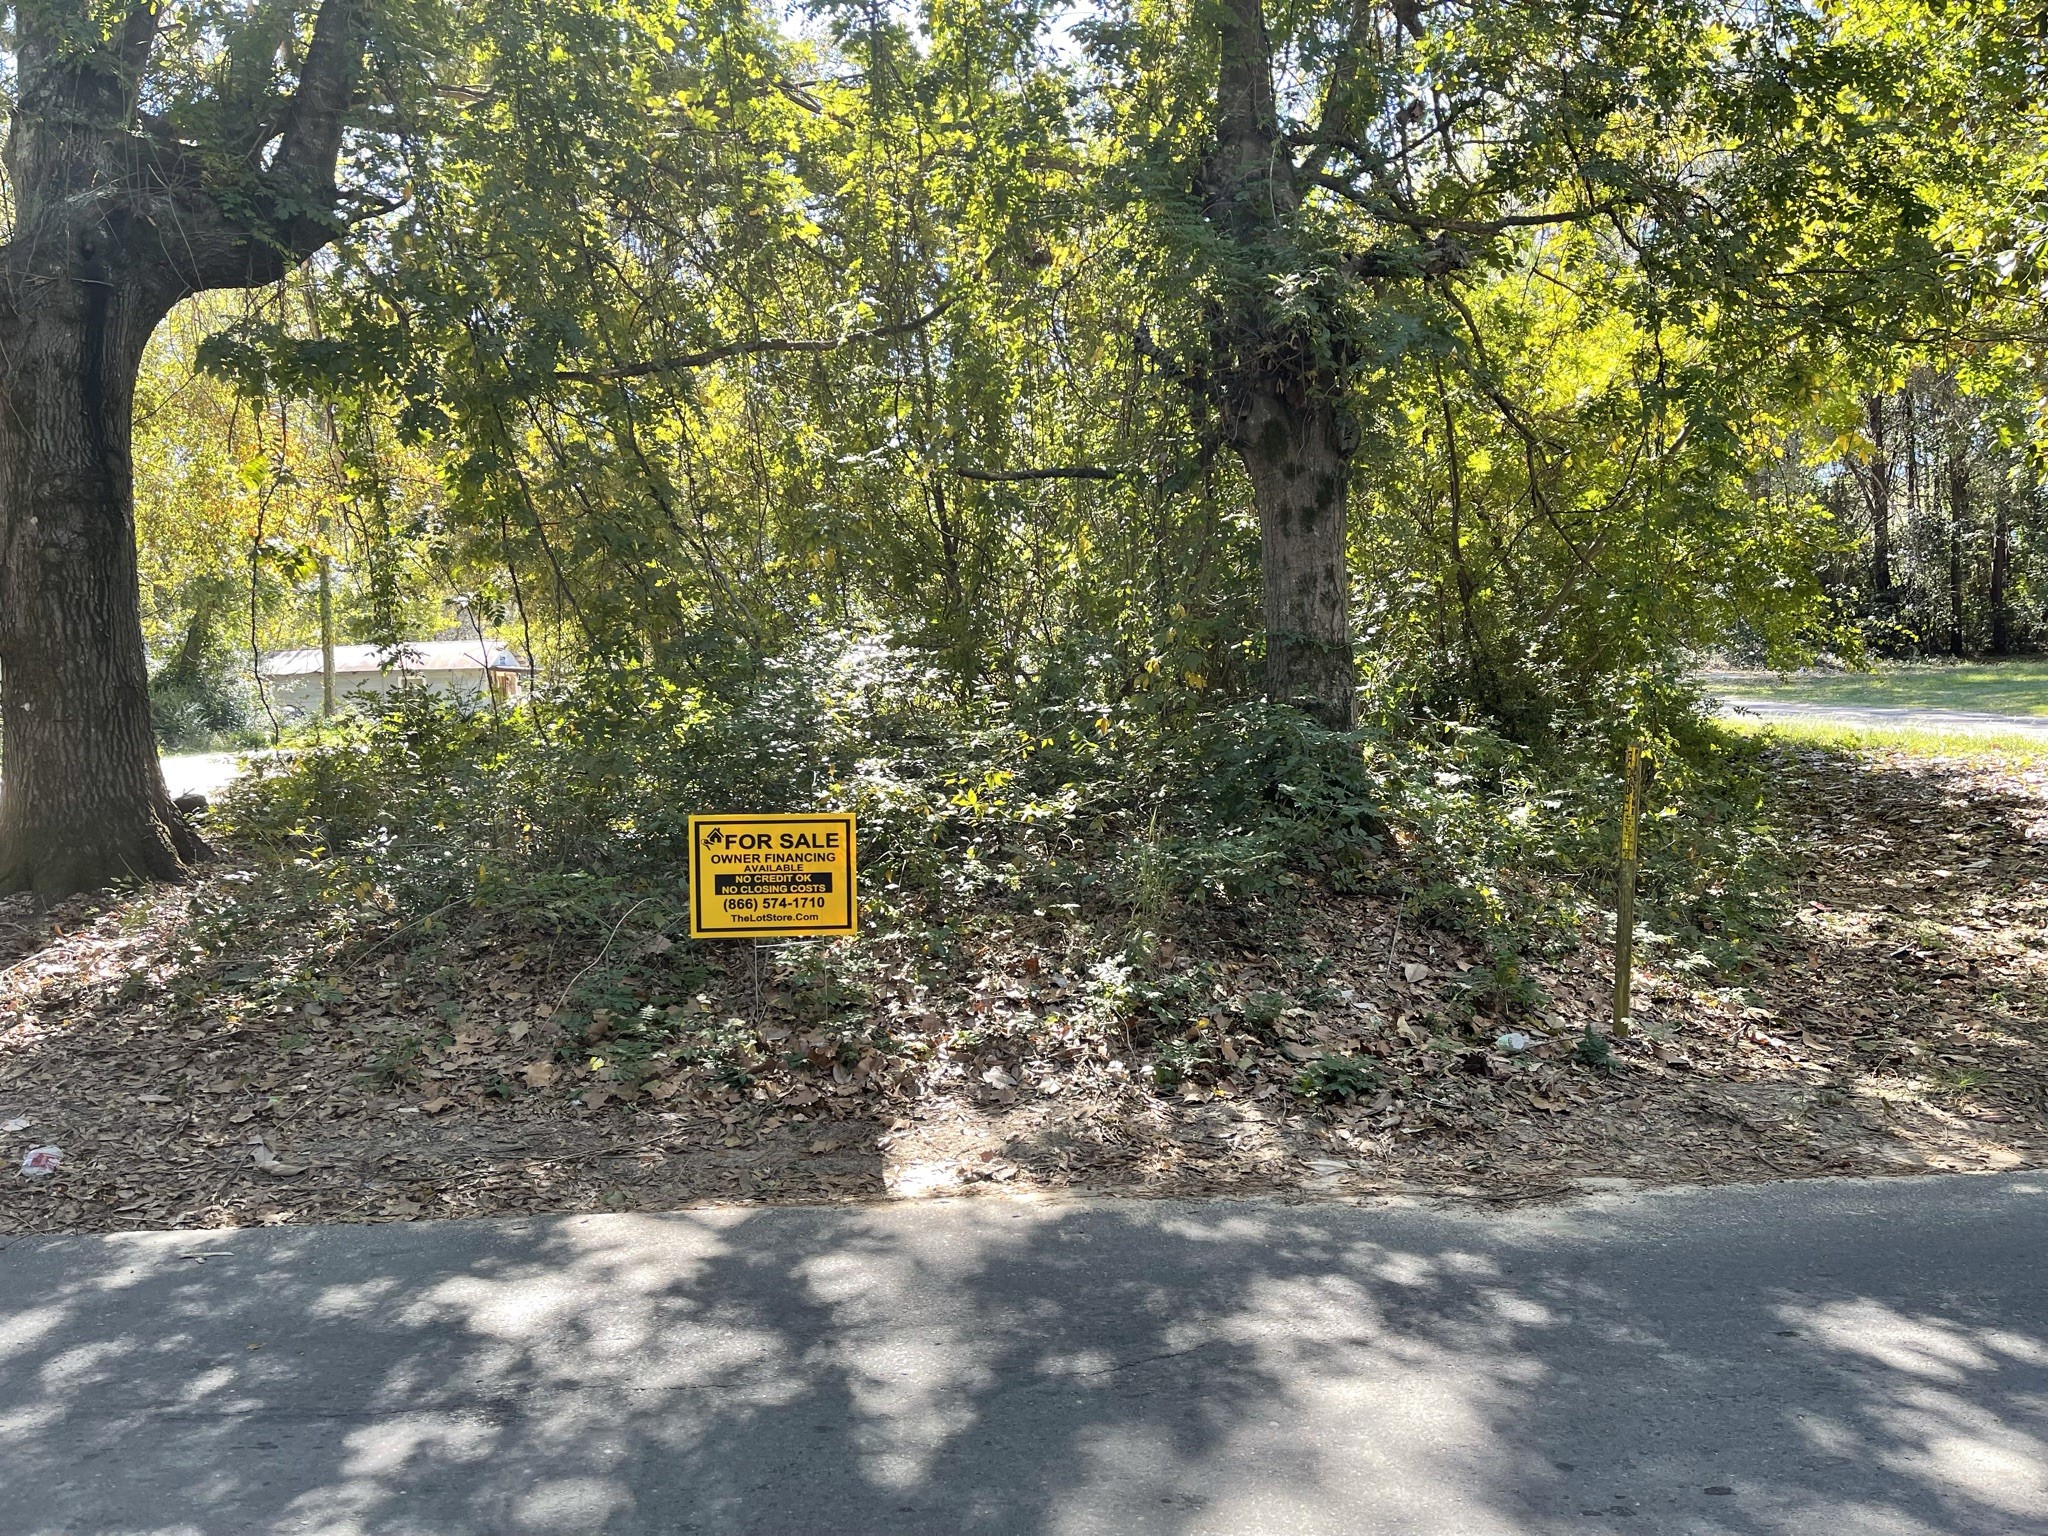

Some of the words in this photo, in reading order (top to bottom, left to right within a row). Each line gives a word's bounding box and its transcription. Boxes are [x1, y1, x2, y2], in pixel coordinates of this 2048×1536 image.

[725, 834, 773, 850] FOR
[779, 833, 839, 849] SALE
[711, 853, 761, 864] OWNER
[765, 853, 836, 863] FINANCING
[744, 864, 804, 873] AVAILABLE
[735, 875, 751, 883] NO
[753, 874, 793, 883] CREDIT
[795, 874, 812, 882] OK
[722, 886, 738, 894] NO
[740, 885, 788, 894] CLOSING
[790, 884, 826, 893] COSTS
[723, 898, 758, 912] (866)
[762, 897, 825, 909] 574-1710
[731, 913, 819, 923] TheLotStore.Com
